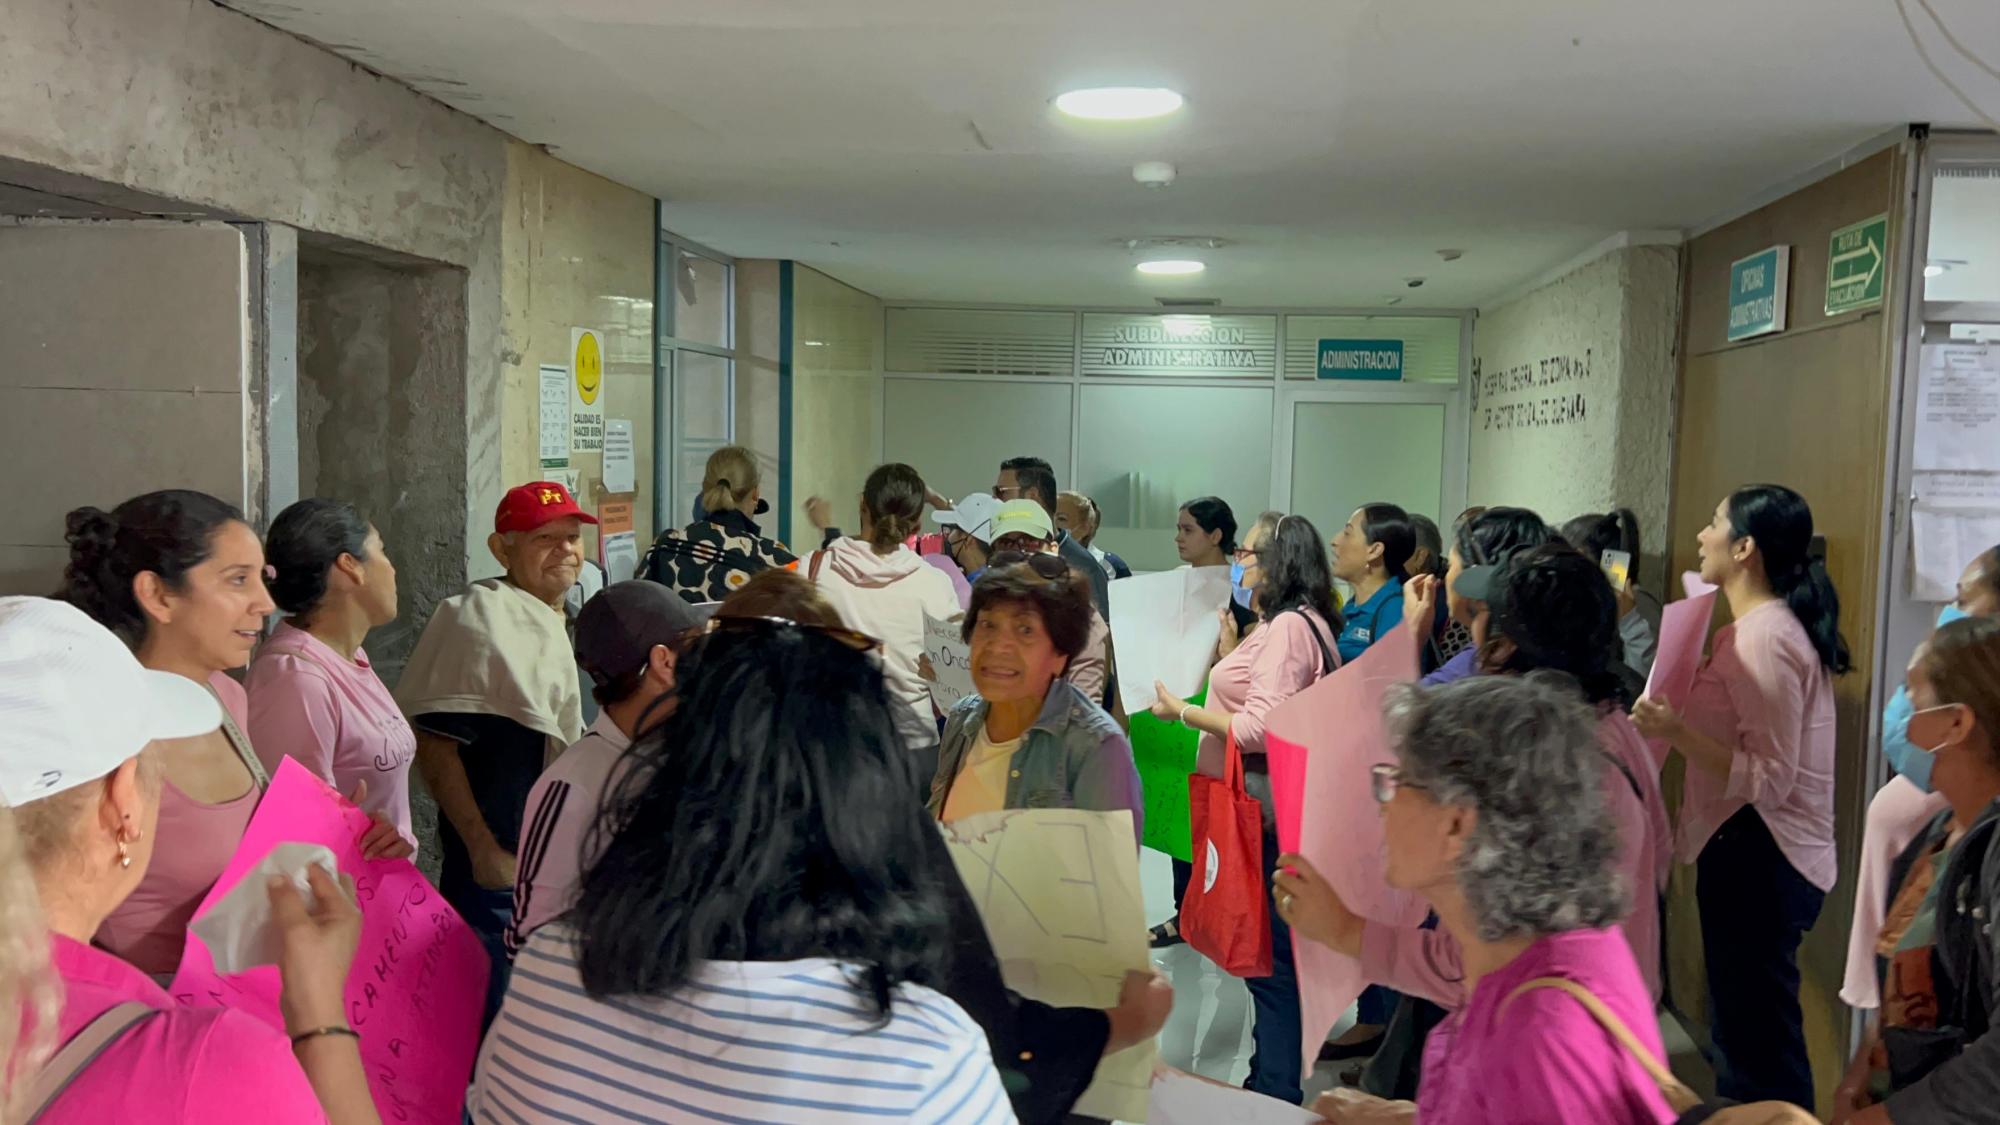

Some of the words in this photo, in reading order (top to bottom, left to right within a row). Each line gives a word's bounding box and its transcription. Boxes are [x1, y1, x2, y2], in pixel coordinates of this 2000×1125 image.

[1102, 348, 1256, 367] ADMINISTRATIVA
[1321, 350, 1399, 370] ADMINISTRACION
[574, 413, 595, 425] CALIDAD
[595, 414, 601, 425] ES
[574, 426, 589, 437] HACER
[590, 426, 602, 437] BIEN
[574, 439, 581, 450] SU
[582, 439, 603, 450] TRABAJO
